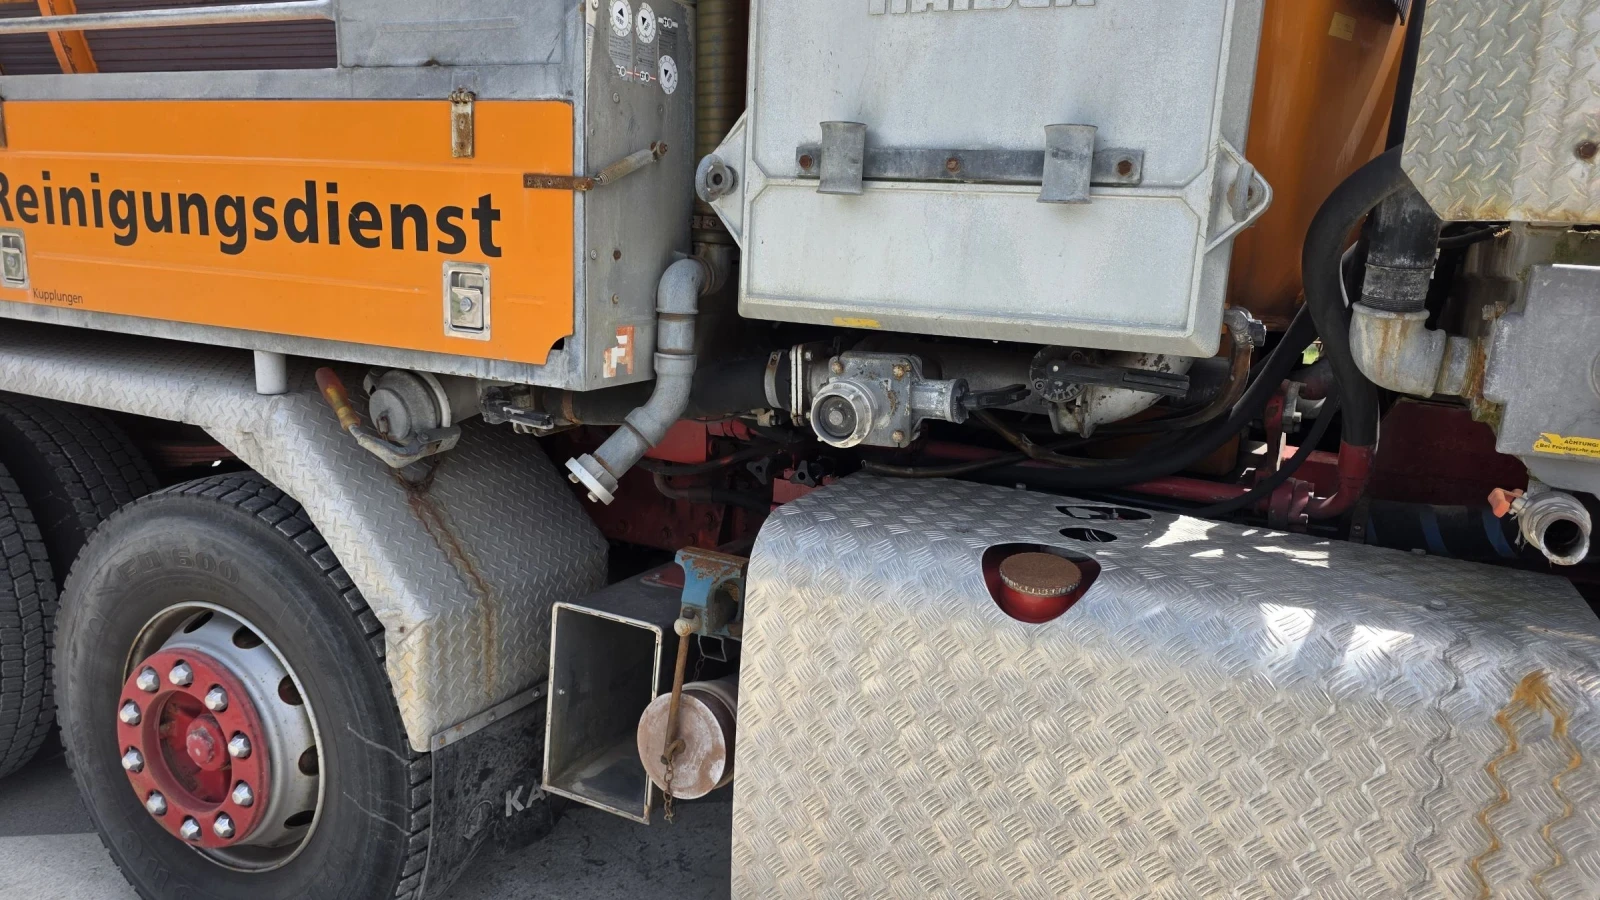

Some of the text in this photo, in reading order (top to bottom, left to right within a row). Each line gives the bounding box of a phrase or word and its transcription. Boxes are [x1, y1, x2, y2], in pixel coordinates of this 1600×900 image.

[0, 169, 503, 258] Reinigungsdienst
[32, 287, 84, 306] Kupplungen
[505, 780, 550, 817] KA
